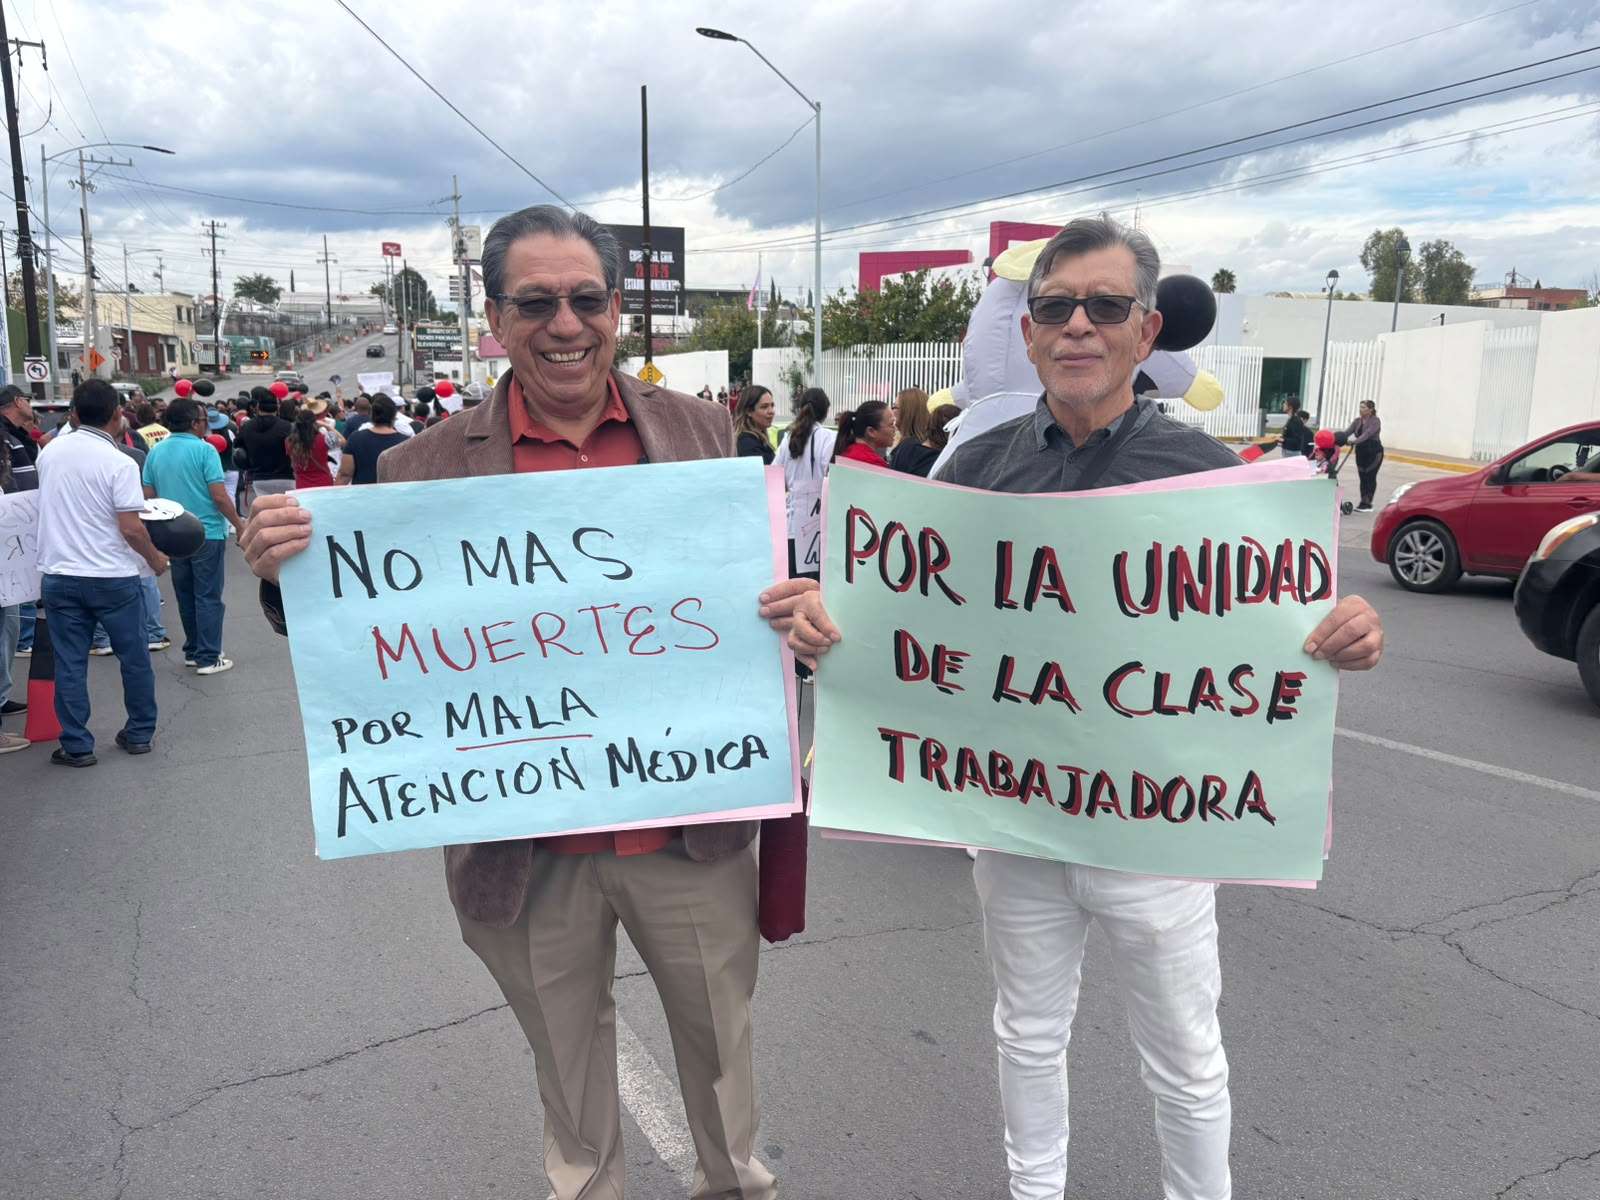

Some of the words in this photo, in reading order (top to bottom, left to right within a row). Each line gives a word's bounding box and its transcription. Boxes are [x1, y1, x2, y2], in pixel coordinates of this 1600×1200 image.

[460, 527, 633, 586] MAS
[845, 504, 967, 606] POR
[994, 540, 1077, 614] LA
[1112, 536, 1333, 622] UNIDAD
[372, 597, 720, 680] MUERTES
[893, 628, 971, 696] DE
[991, 654, 1082, 715] LA
[1102, 660, 1308, 725] CLASE
[331, 711, 423, 754] POR
[445, 686, 598, 738] MALA
[337, 746, 585, 838] ATENCION
[877, 727, 1277, 827] TRABAJADORA
